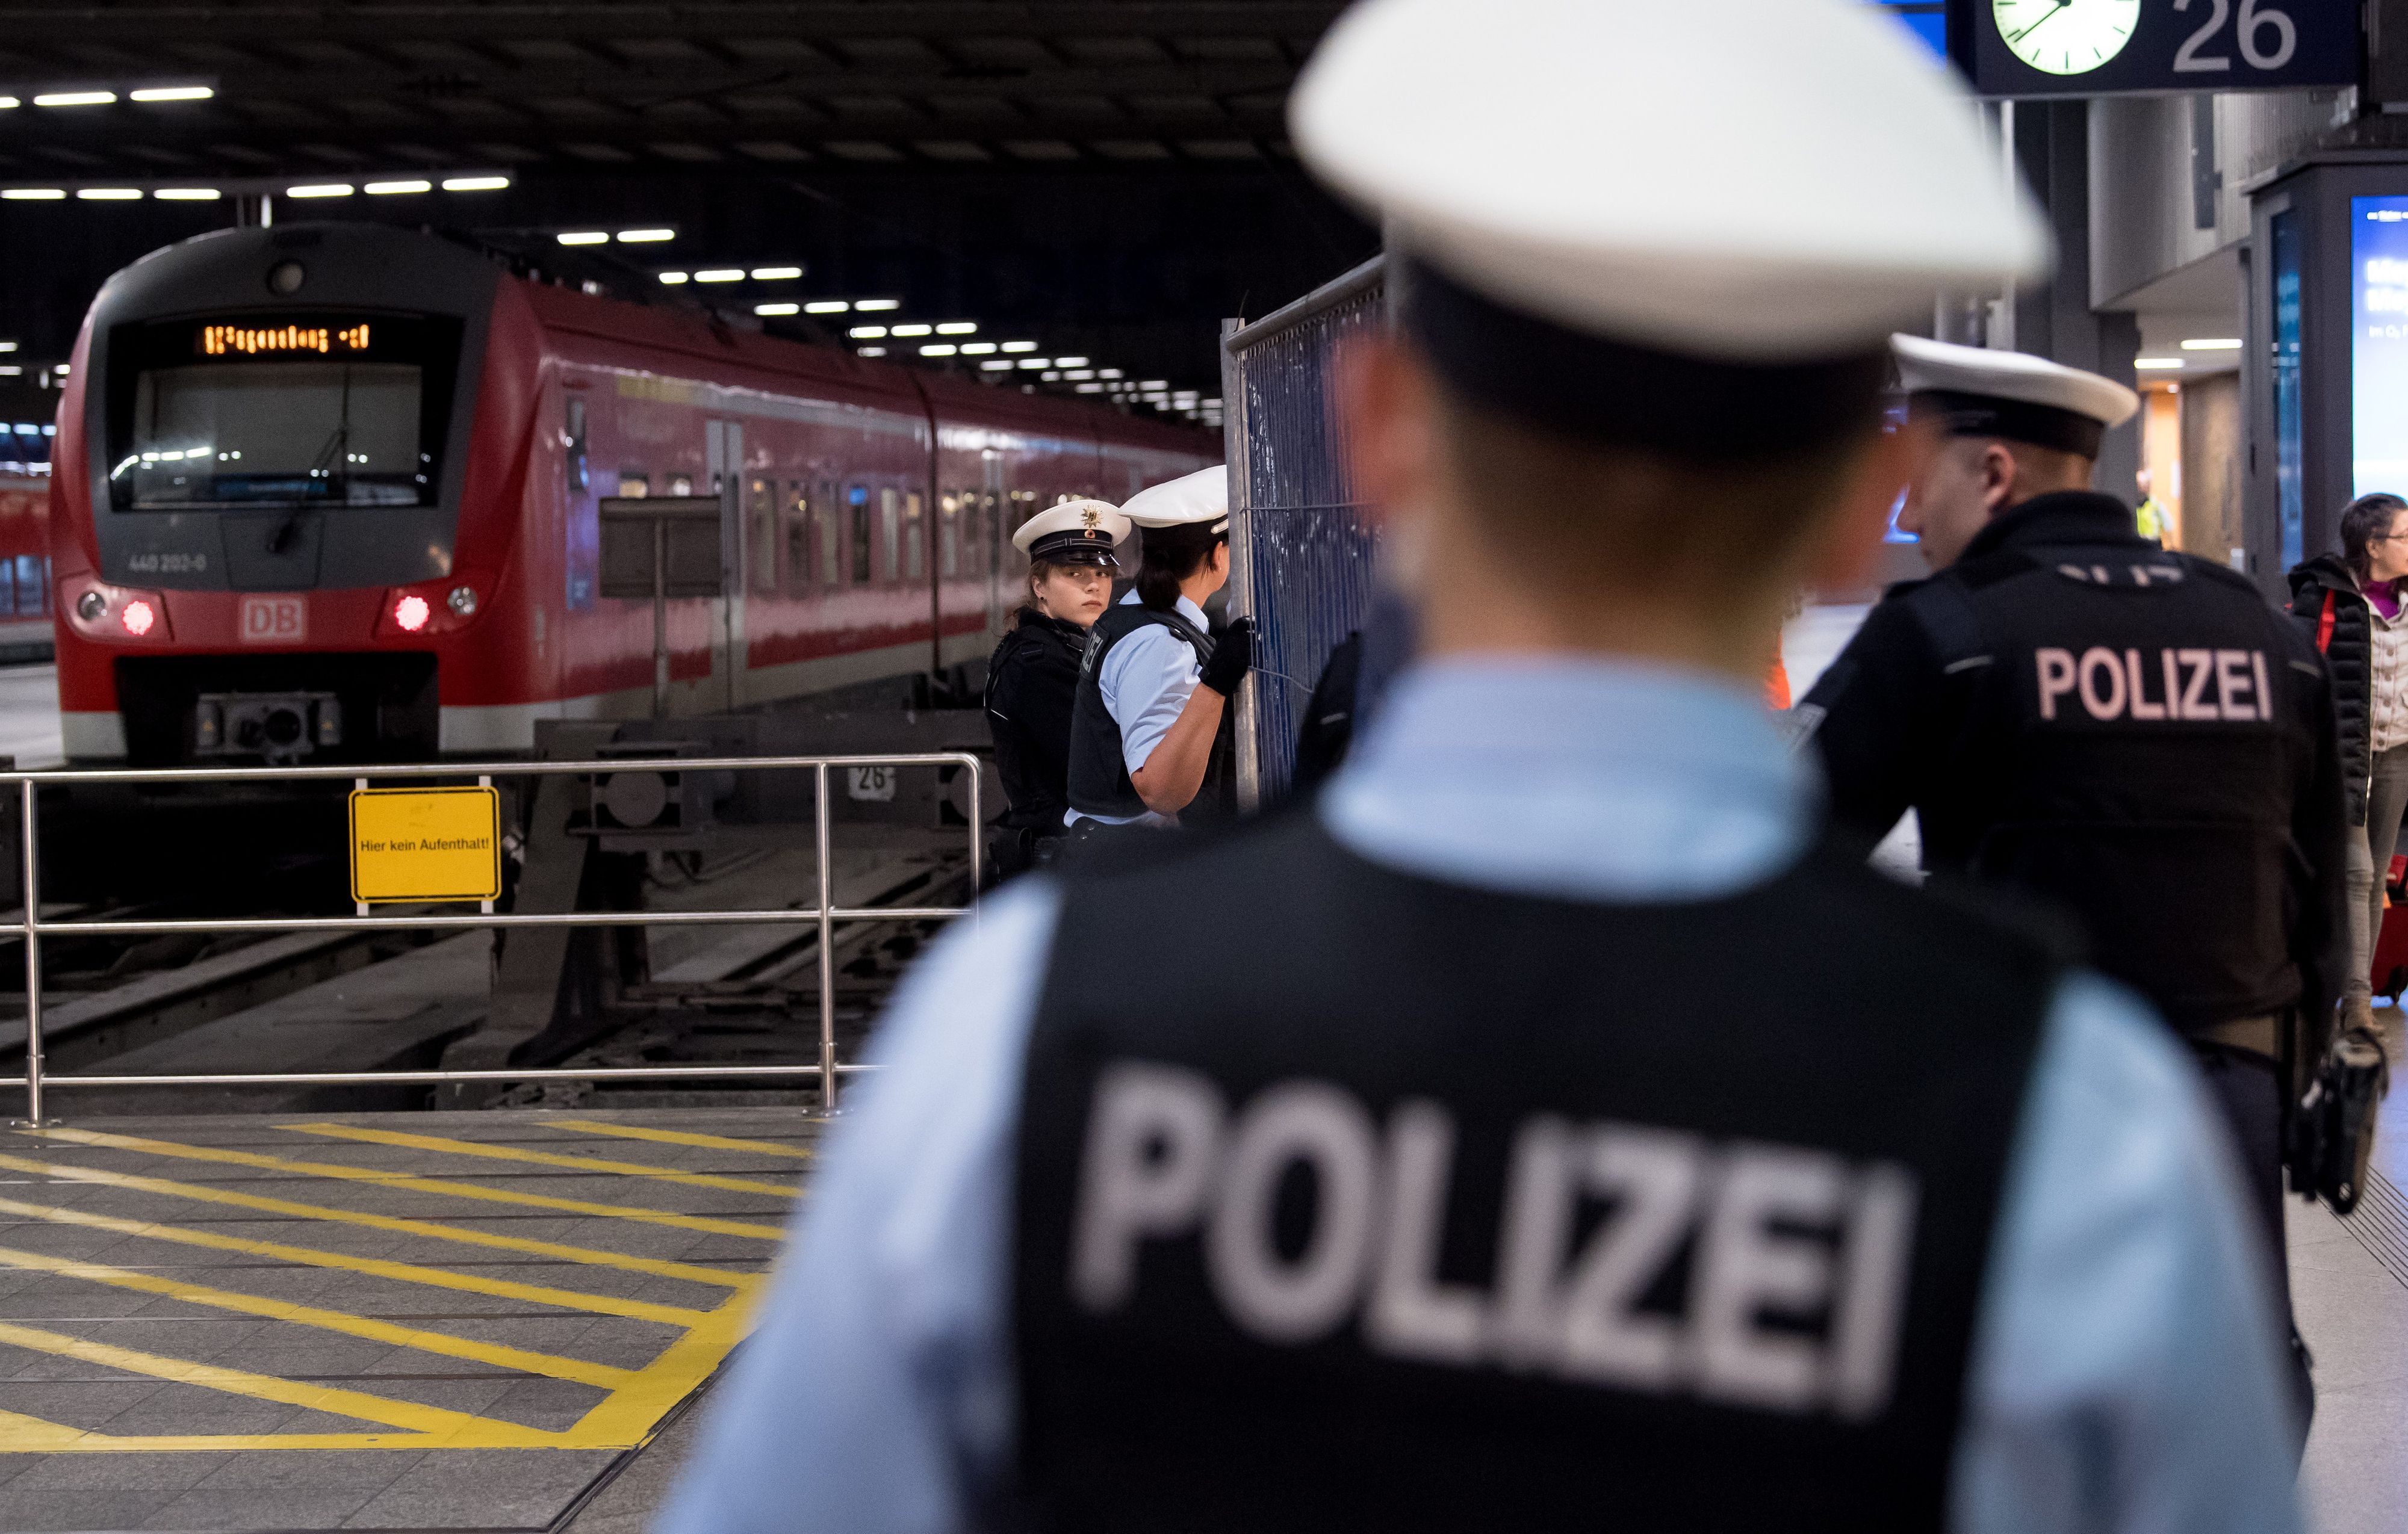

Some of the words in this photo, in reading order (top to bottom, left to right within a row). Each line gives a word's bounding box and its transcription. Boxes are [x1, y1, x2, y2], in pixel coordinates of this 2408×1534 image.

[2173, 0, 2297, 72] 26
[249, 603, 299, 634] DB
[2035, 646, 2273, 721] POLIZEI
[361, 840, 385, 852] Hier
[389, 839, 417, 851] kein
[420, 837, 489, 851] Aufenthalt!
[1072, 1062, 1917, 1411] POLIZEI
